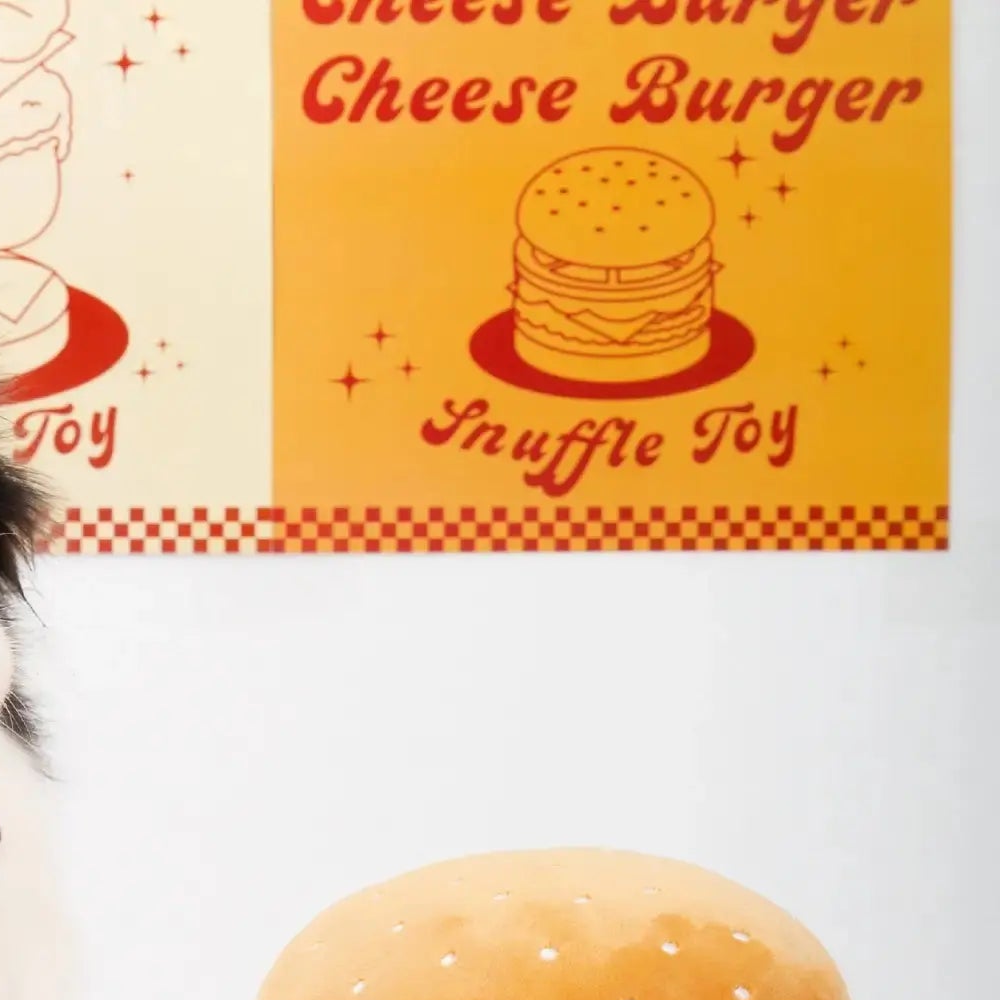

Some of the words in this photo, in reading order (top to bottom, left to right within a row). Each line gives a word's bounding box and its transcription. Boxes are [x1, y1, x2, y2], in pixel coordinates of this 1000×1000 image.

[302, 54, 578, 124] Cheese
[609, 54, 923, 154] Burger
[13, 404, 117, 469] Toy
[420, 398, 664, 498] Snuffle
[692, 402, 798, 468] Toy
